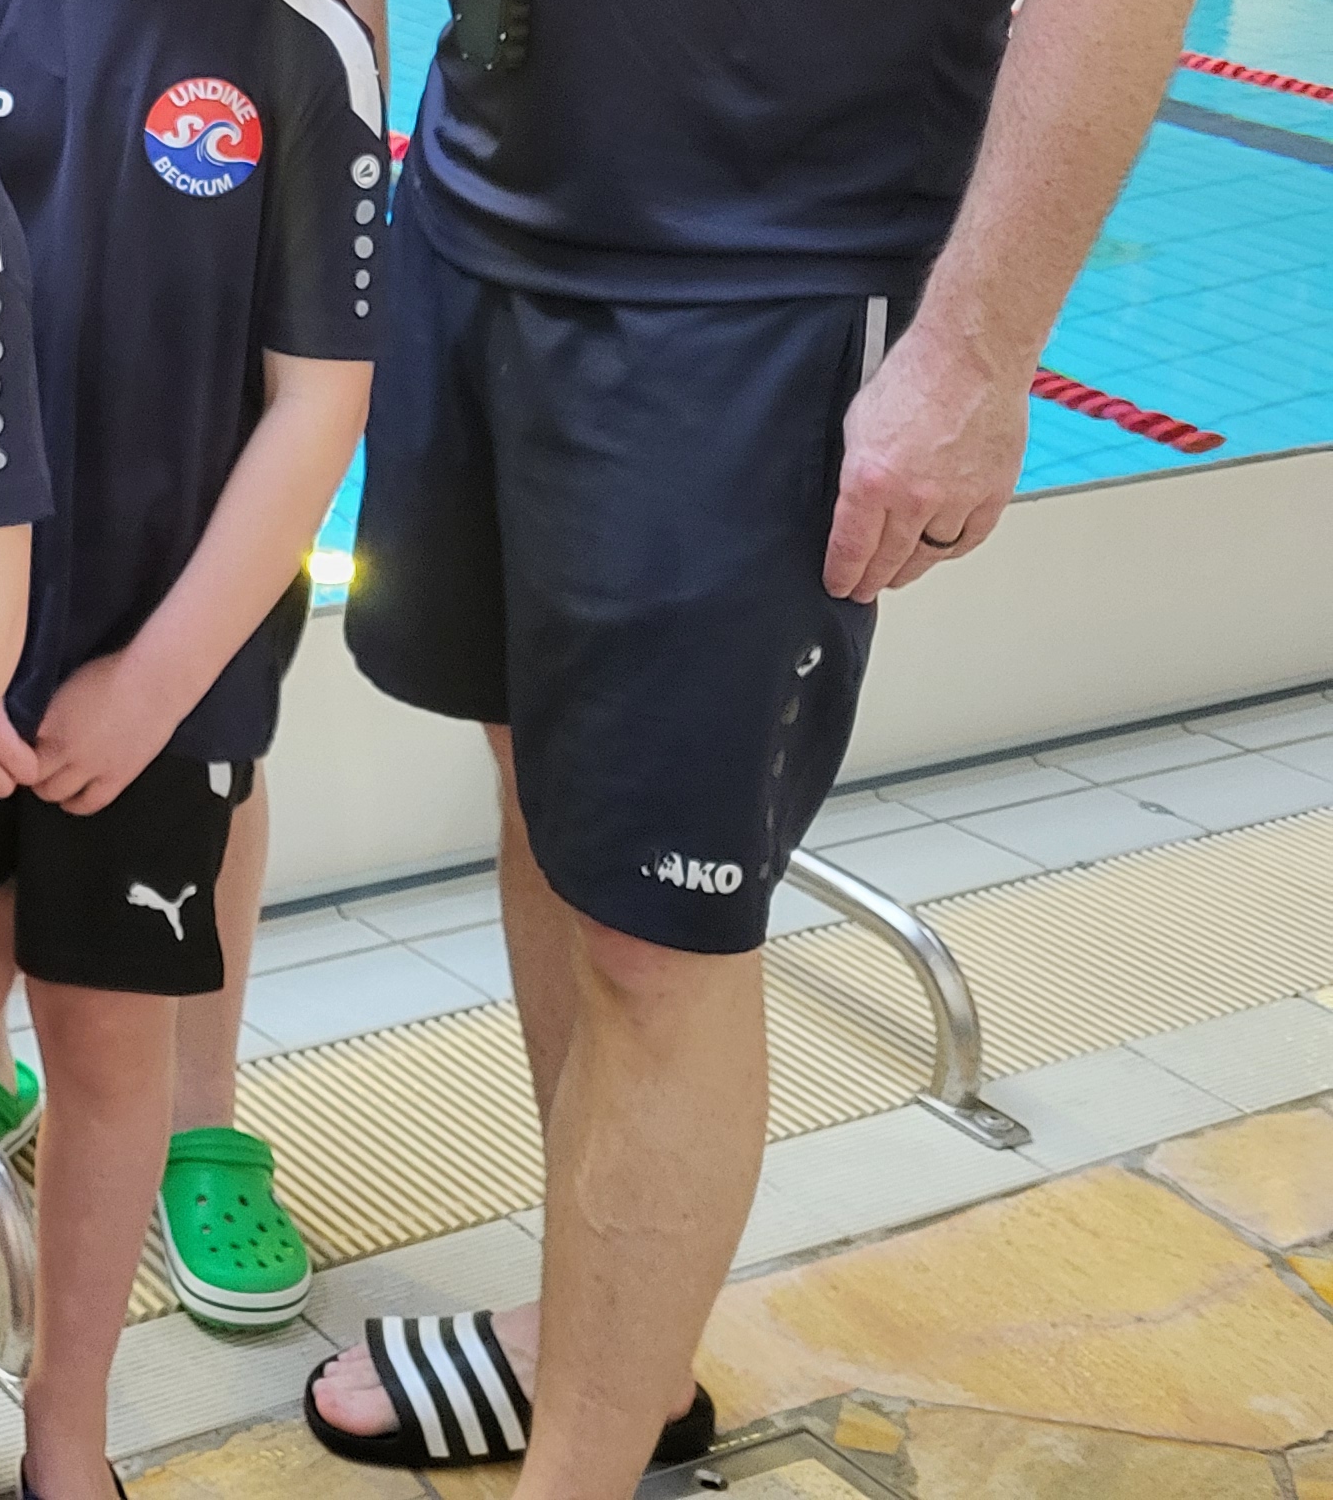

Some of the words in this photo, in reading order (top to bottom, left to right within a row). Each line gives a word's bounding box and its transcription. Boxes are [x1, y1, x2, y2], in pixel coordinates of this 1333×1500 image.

[168, 80, 257, 125] UNDINE
[153, 156, 233, 196] BECKUM
[640, 852, 743, 894] AKO
